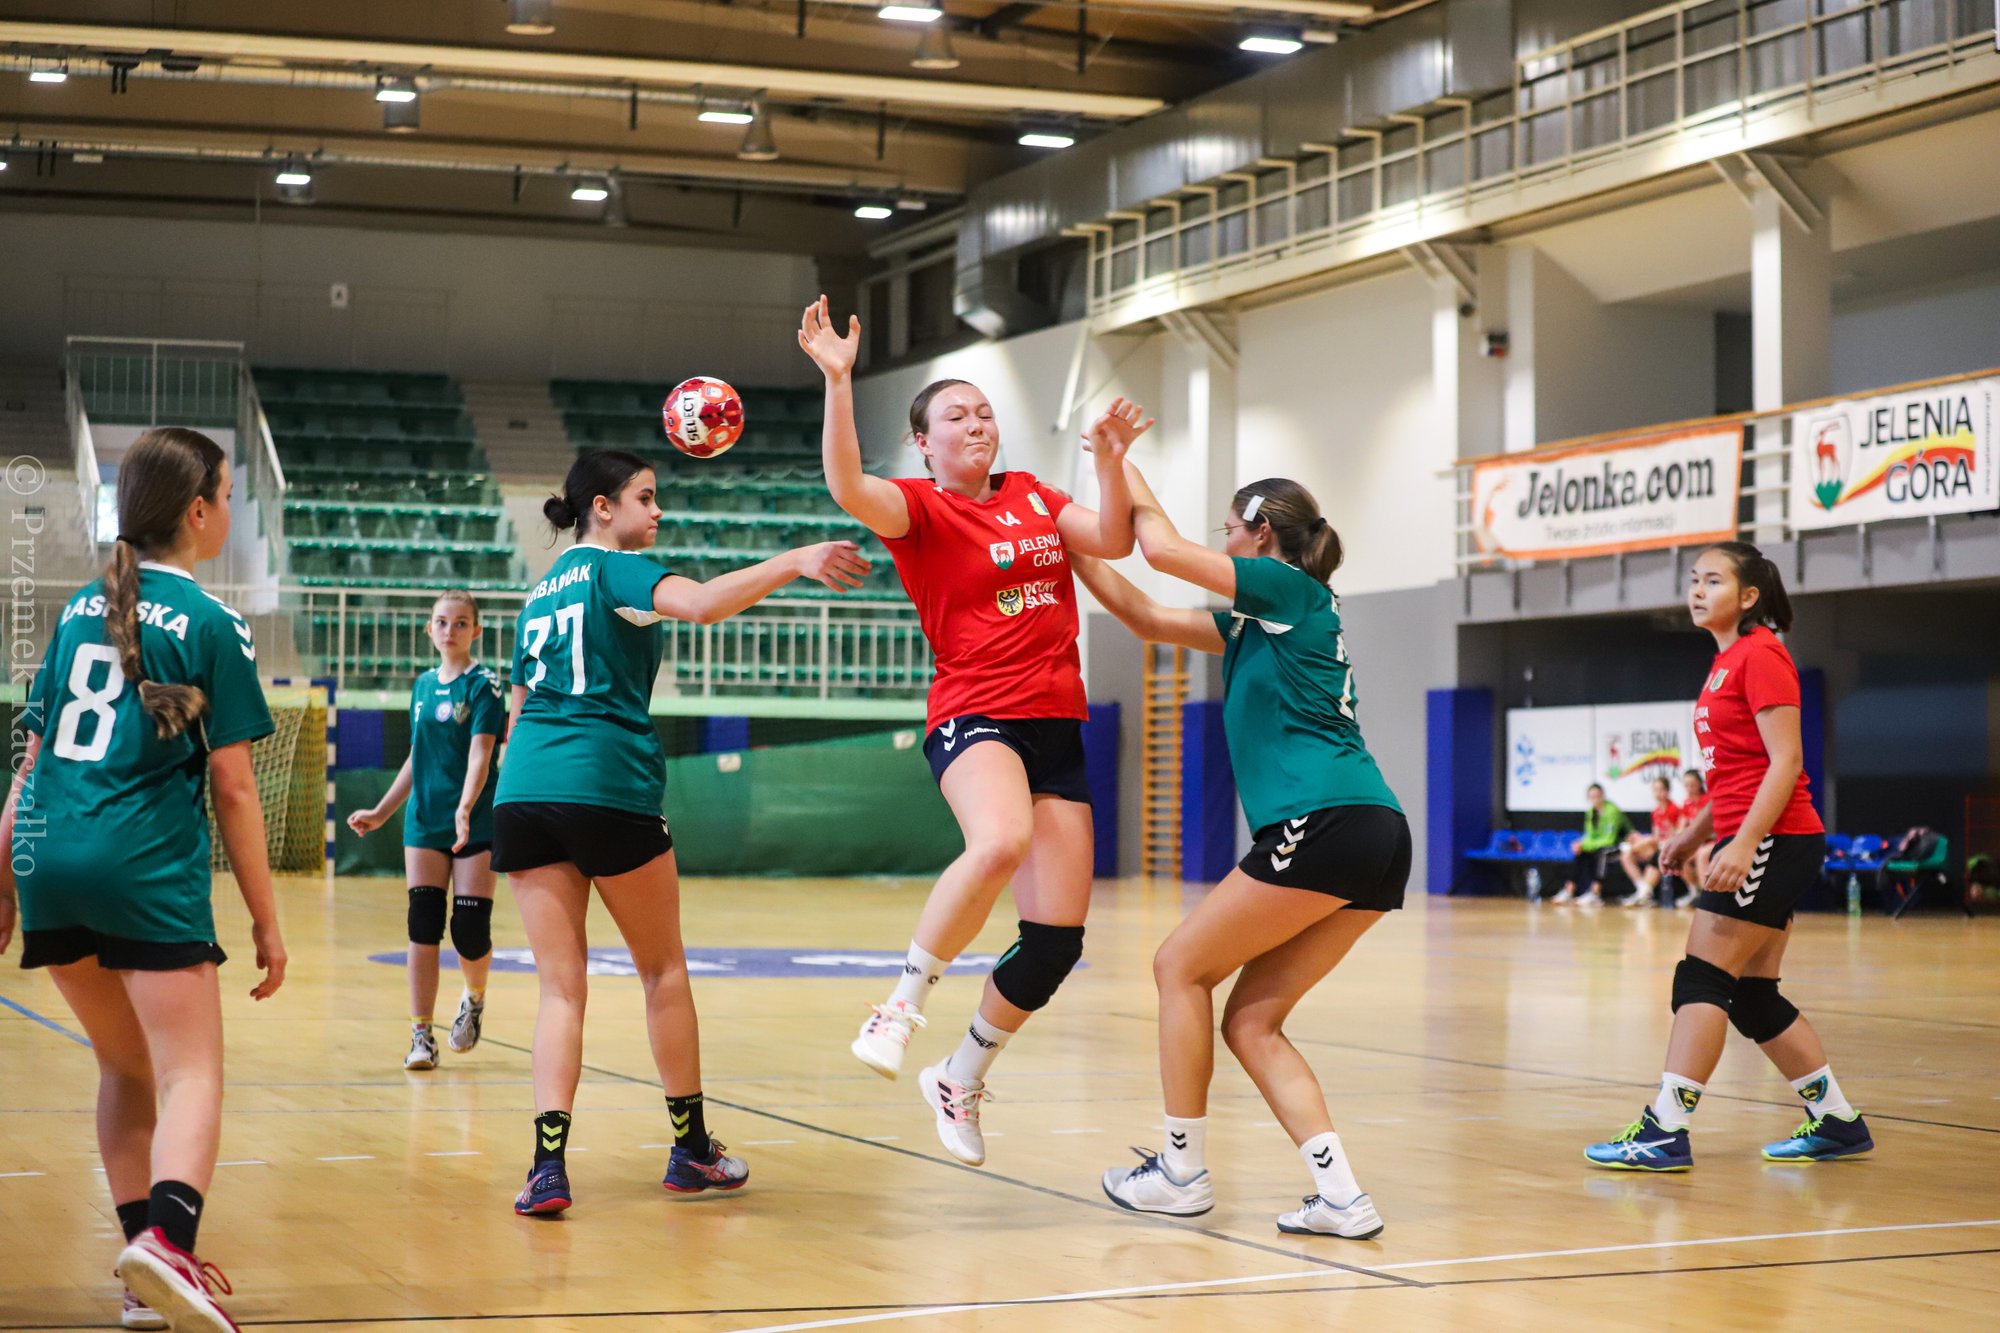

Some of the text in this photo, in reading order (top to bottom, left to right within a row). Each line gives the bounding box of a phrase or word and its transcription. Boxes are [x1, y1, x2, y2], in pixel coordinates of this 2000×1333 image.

[684, 397, 702, 441] SELECT
[1859, 396, 1974, 449] JELENIA
[1518, 457, 1715, 519] Jelonka.com
[1887, 448, 1973, 504] GÓRA
[1033, 549, 1064, 567] GÓRA
[523, 602, 586, 694] 77
[53, 643, 125, 762] 8
